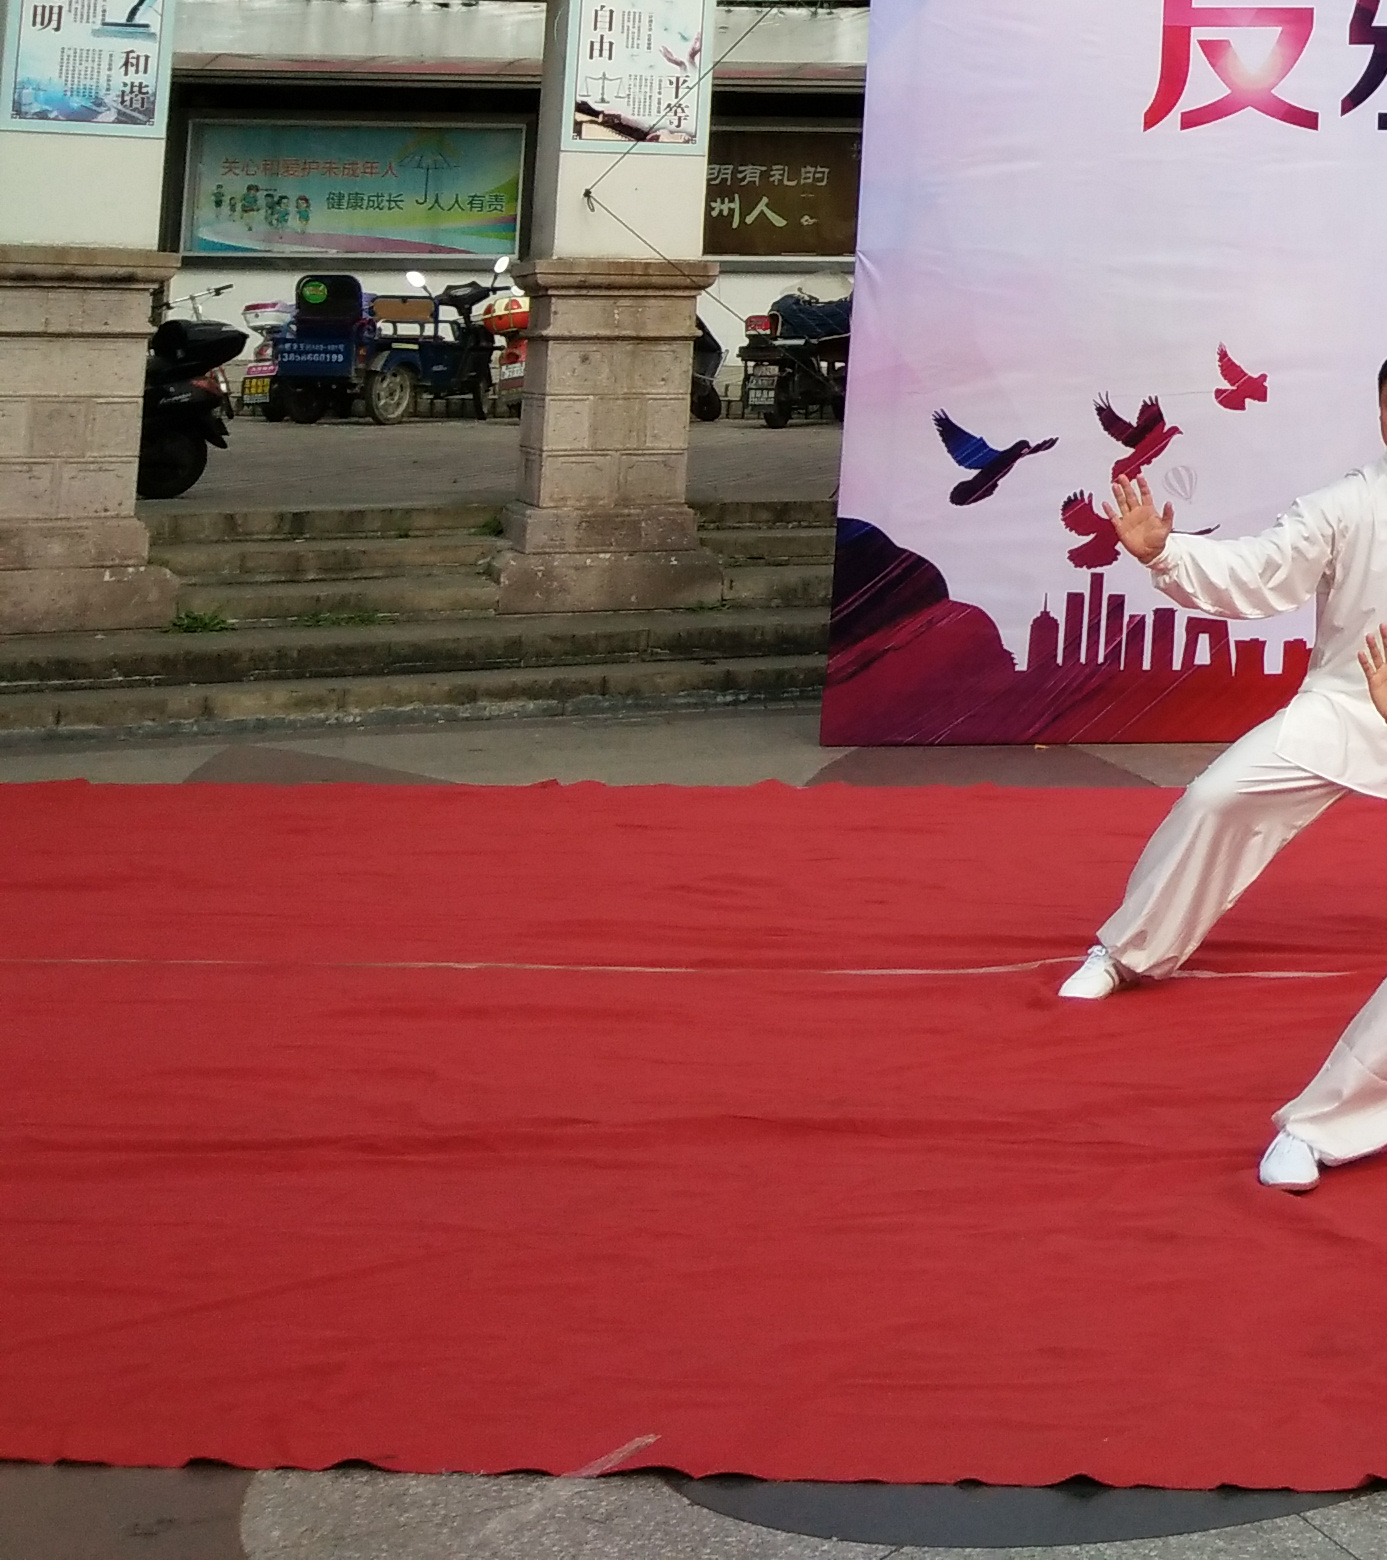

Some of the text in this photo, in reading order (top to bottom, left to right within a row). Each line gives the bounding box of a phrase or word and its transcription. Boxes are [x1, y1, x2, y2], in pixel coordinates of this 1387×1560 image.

[588, 5, 615, 61] 自由
[118, 49, 151, 110] 和谐
[663, 74, 692, 128] 平等
[221, 157, 400, 179] 关心和爱护未成年人
[706, 164, 830, 186] 明有礼的
[326, 191, 505, 213] 健康成长 人人有责
[710, 193, 788, 229] 州人
